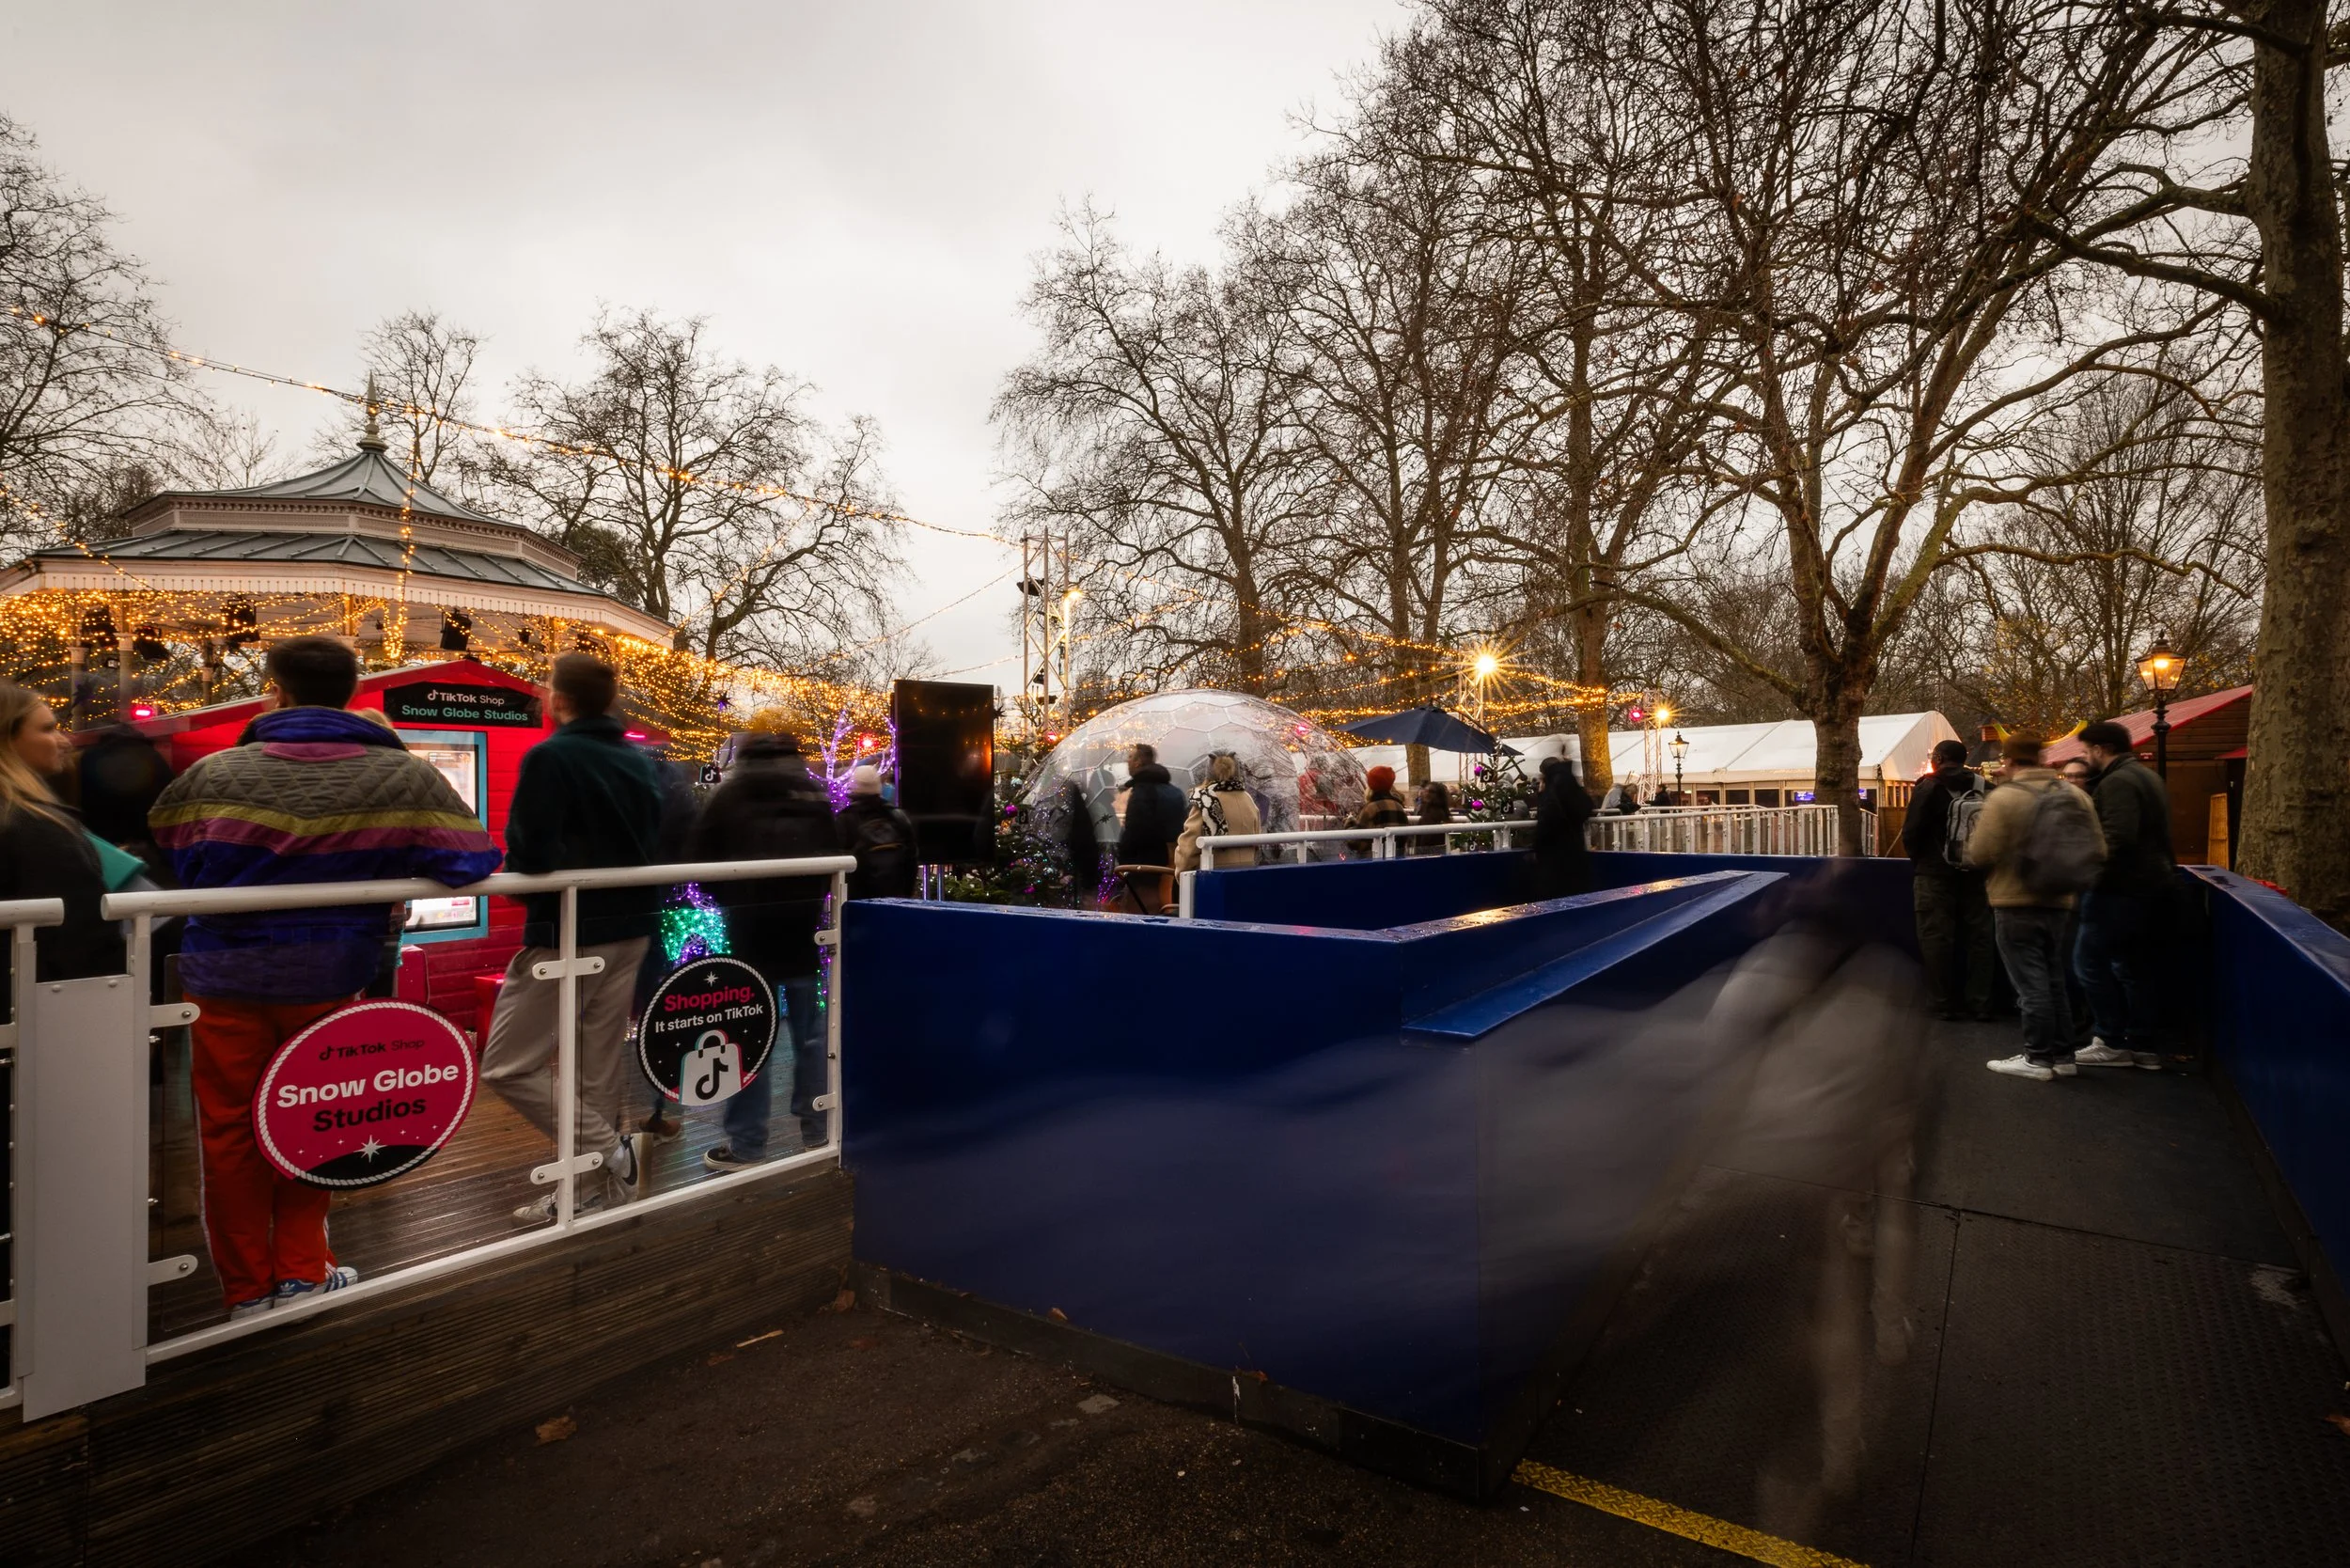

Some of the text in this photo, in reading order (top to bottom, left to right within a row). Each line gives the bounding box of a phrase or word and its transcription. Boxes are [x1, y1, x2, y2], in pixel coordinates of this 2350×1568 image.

[440, 692, 505, 707] TikTok Shop
[401, 705, 527, 721] Snow Globe Studios
[664, 985, 755, 1011] Shopping.
[655, 1003, 763, 1033] It starts on TikTok
[337, 1038, 425, 1058] TikTok Shop
[276, 1063, 459, 1107] Snow Globe
[313, 1098, 427, 1132] Studios
